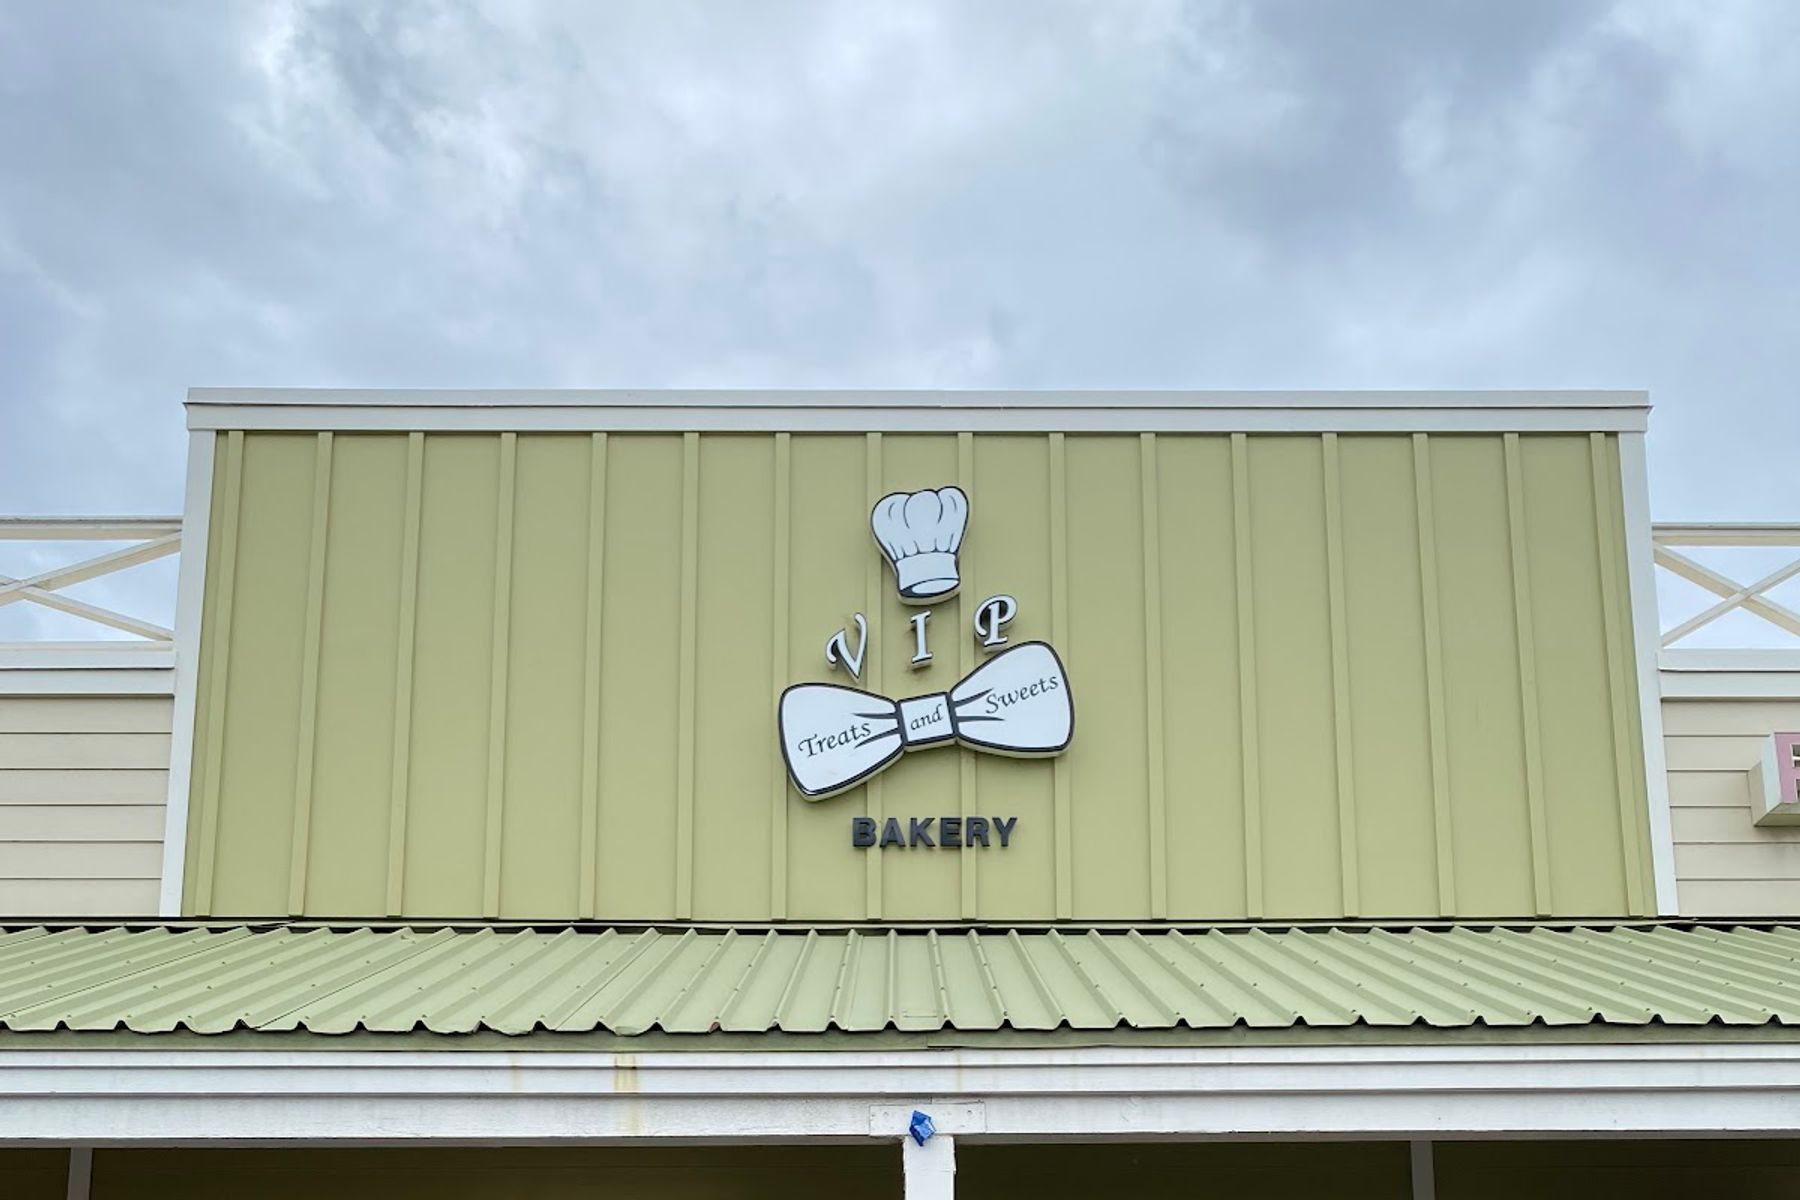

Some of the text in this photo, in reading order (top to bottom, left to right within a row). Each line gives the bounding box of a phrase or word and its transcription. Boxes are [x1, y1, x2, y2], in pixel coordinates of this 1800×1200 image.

[798, 674, 1060, 758] Treats and Sweets
[851, 816, 1018, 849] BAKERY
